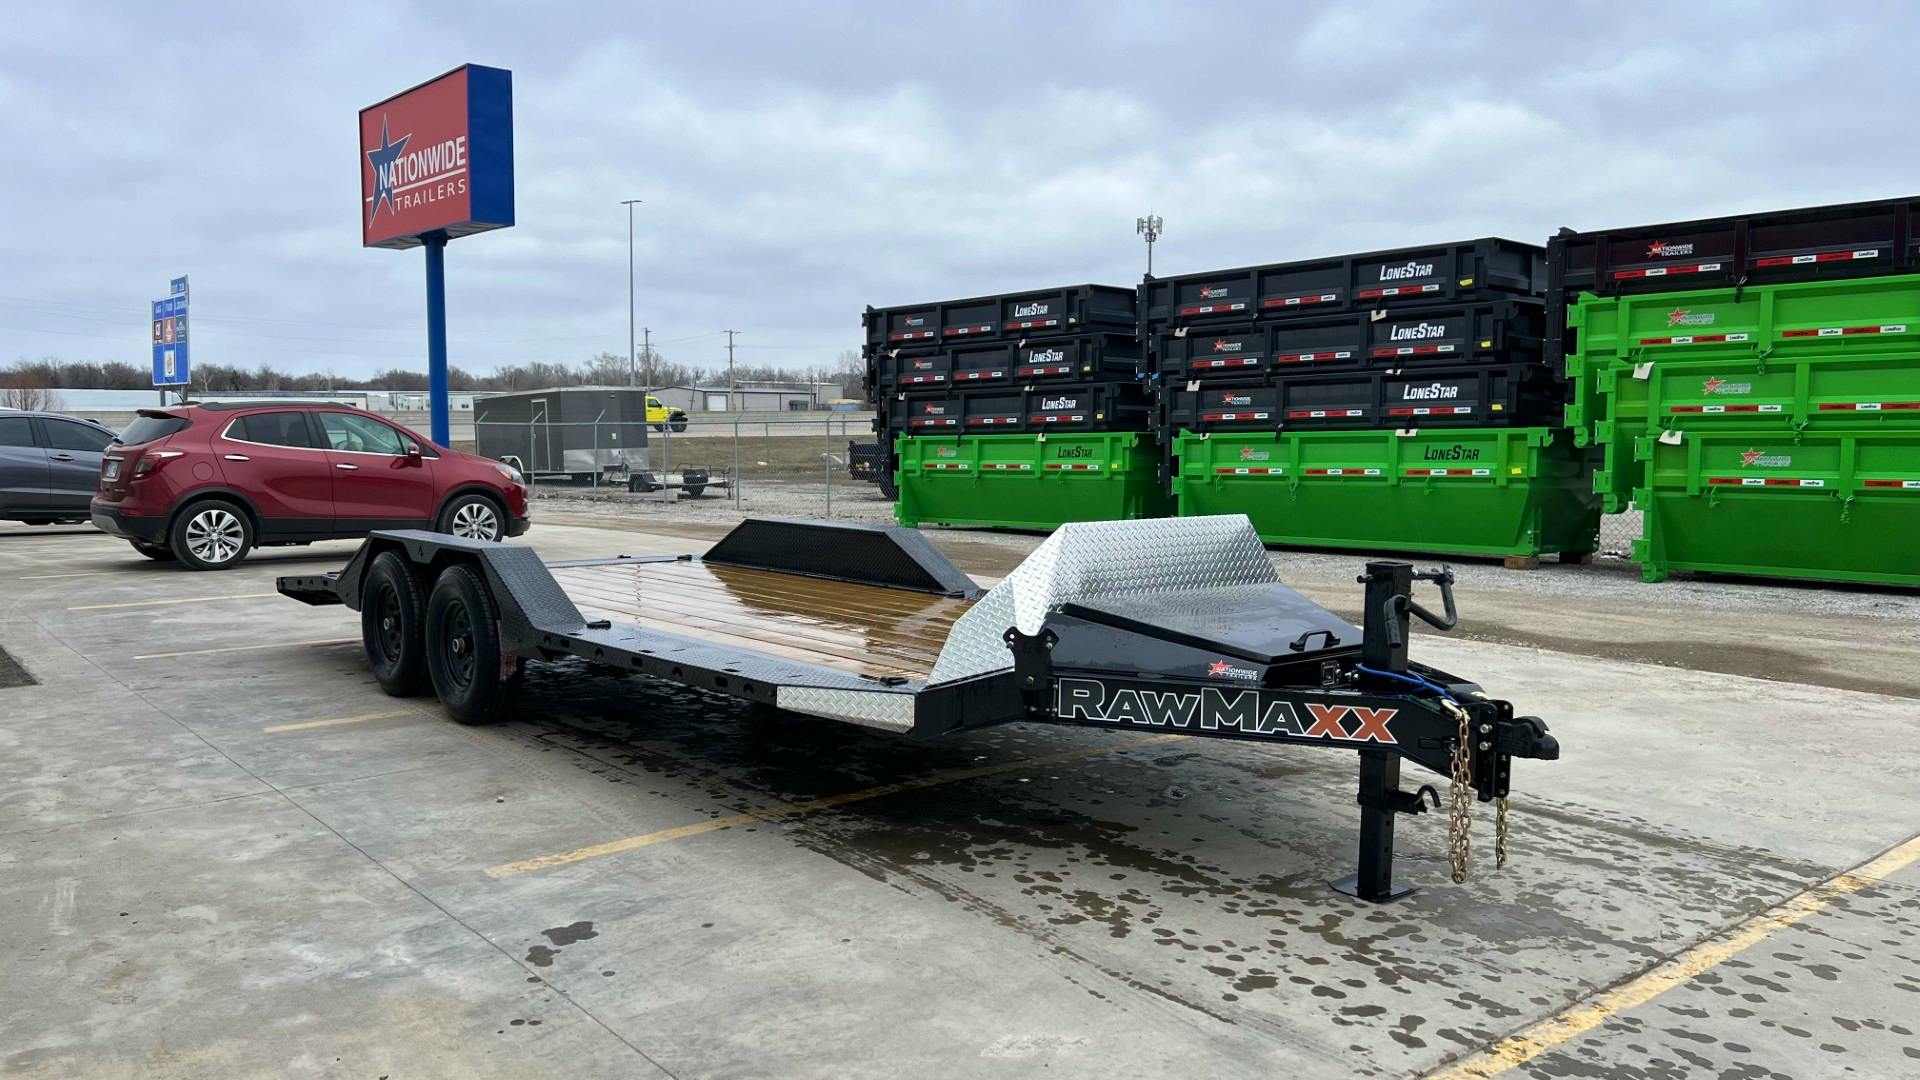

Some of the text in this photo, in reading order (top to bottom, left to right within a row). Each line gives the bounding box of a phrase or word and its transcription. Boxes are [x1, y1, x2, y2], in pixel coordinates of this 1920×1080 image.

[379, 136, 466, 191] NATIONWIDE
[395, 179, 466, 212] TRAILERS
[1652, 243, 1693, 252] NATIONWIDE
[1216, 667, 1257, 675] NATIONWIDE
